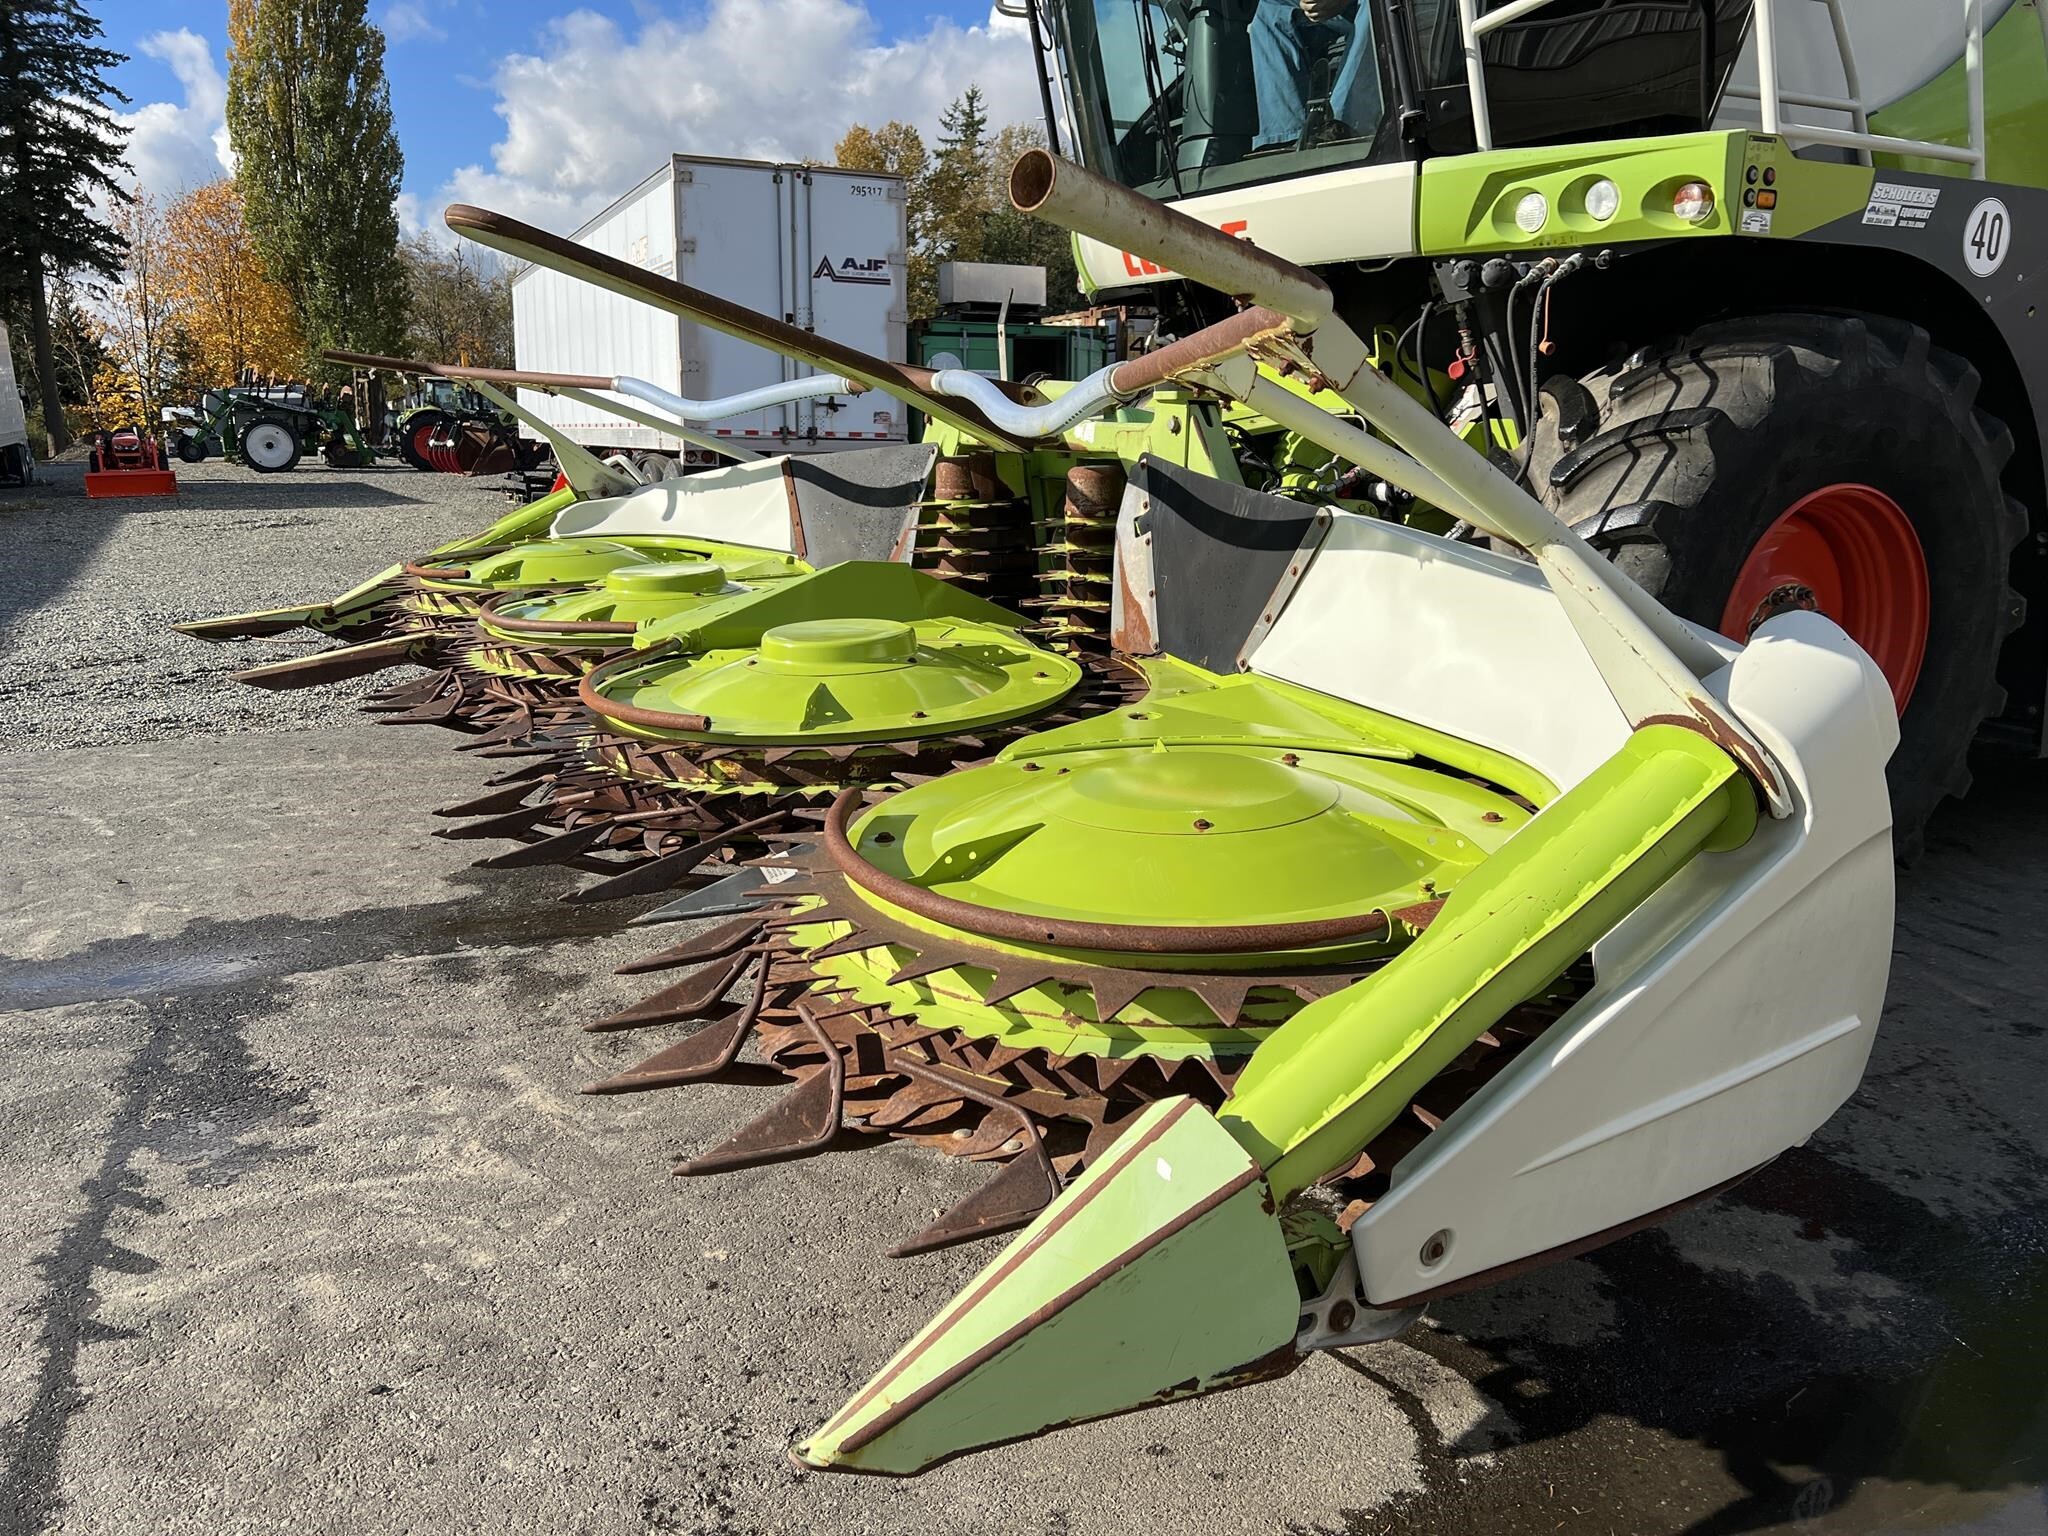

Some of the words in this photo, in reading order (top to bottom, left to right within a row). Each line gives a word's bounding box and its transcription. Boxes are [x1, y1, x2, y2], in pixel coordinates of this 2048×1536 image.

[1872, 186, 1938, 205] SCHOLTEN'S
[1970, 210, 2004, 262] 40
[840, 257, 887, 272] AJF
